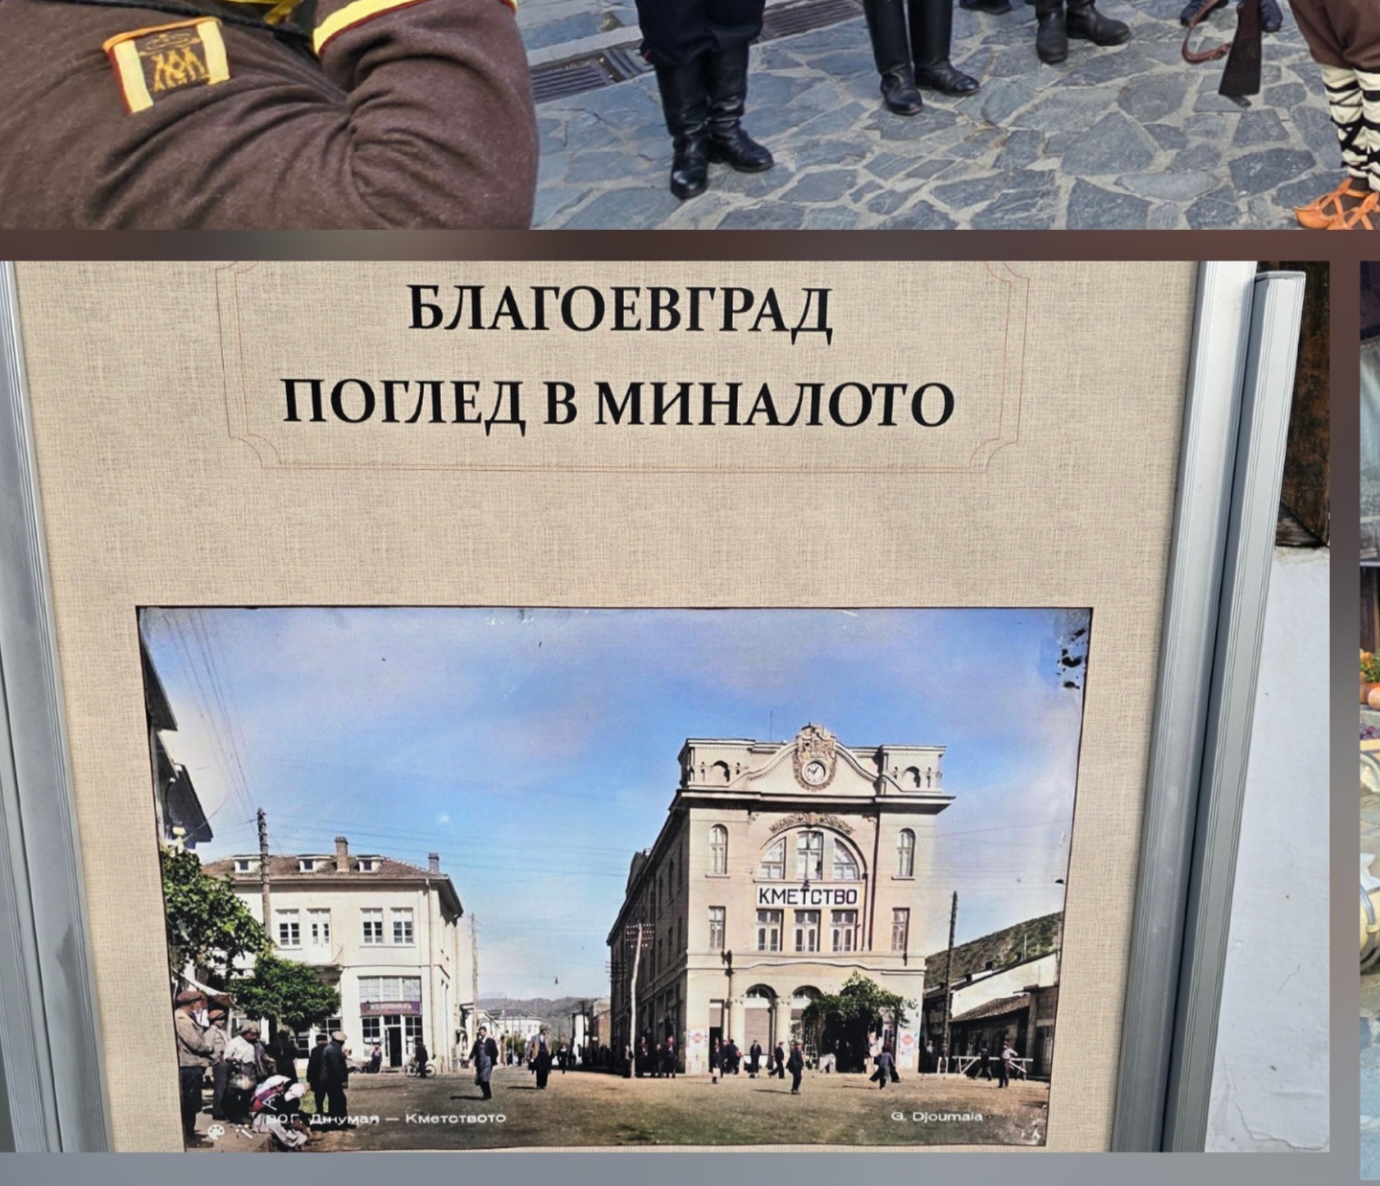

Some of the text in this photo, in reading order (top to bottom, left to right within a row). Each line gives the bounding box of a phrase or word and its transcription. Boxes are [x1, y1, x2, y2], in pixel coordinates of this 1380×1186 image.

[406, 284, 833, 345] БЛАГОЕВГРАД
[280, 378, 956, 437] ПОГЛЕД В МИНАЛОТО
[759, 887, 858, 905] КМЕТСТВО
[405, 1113, 507, 1124] Кметството
[890, 1111, 907, 1122] G.
